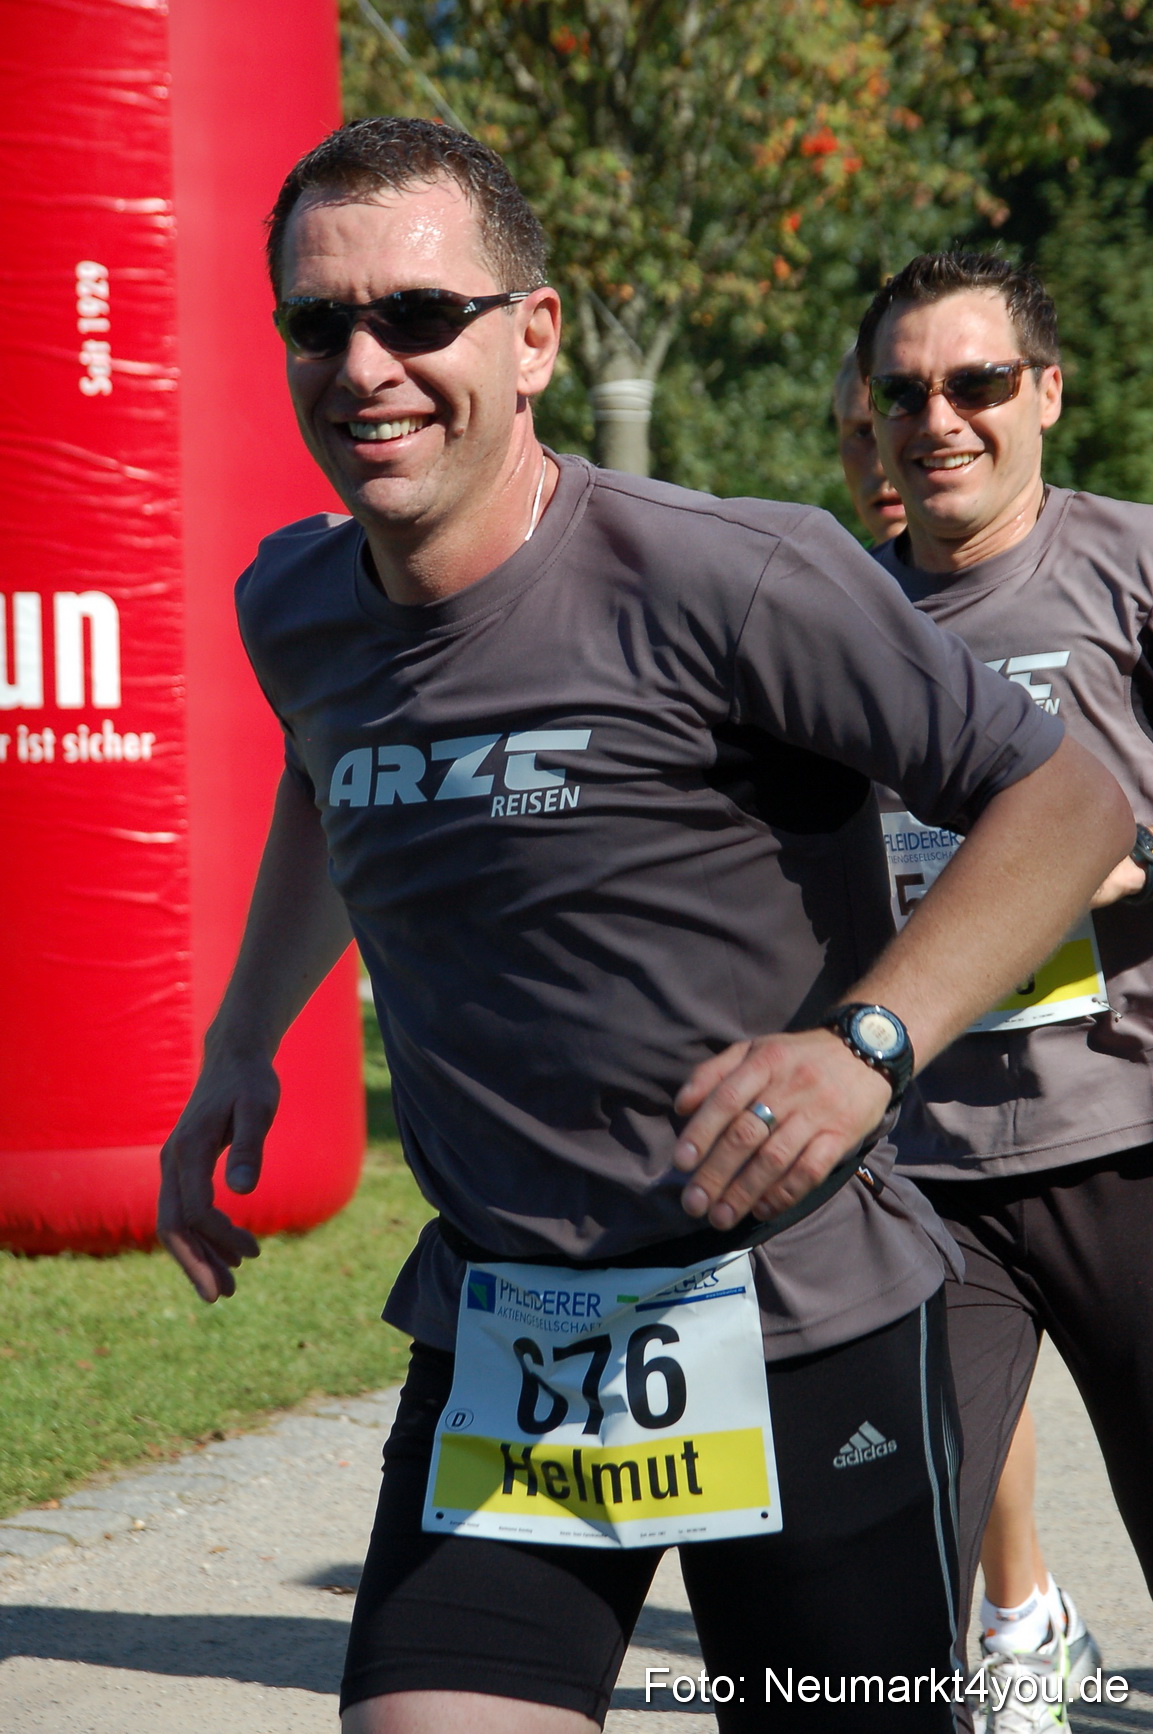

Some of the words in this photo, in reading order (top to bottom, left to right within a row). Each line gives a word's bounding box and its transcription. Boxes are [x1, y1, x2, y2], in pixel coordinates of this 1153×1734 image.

[17, 724, 56, 763] ist
[62, 718, 156, 763] sicher
[491, 785, 581, 818] REISEN
[884, 829, 961, 852] FLEIDERER
[500, 1278, 602, 1318] PFLEIDERER
[512, 1323, 688, 1436] 676
[451, 1411, 466, 1427] D
[833, 1439, 898, 1469] adidas
[500, 1440, 703, 1505] Helmut
